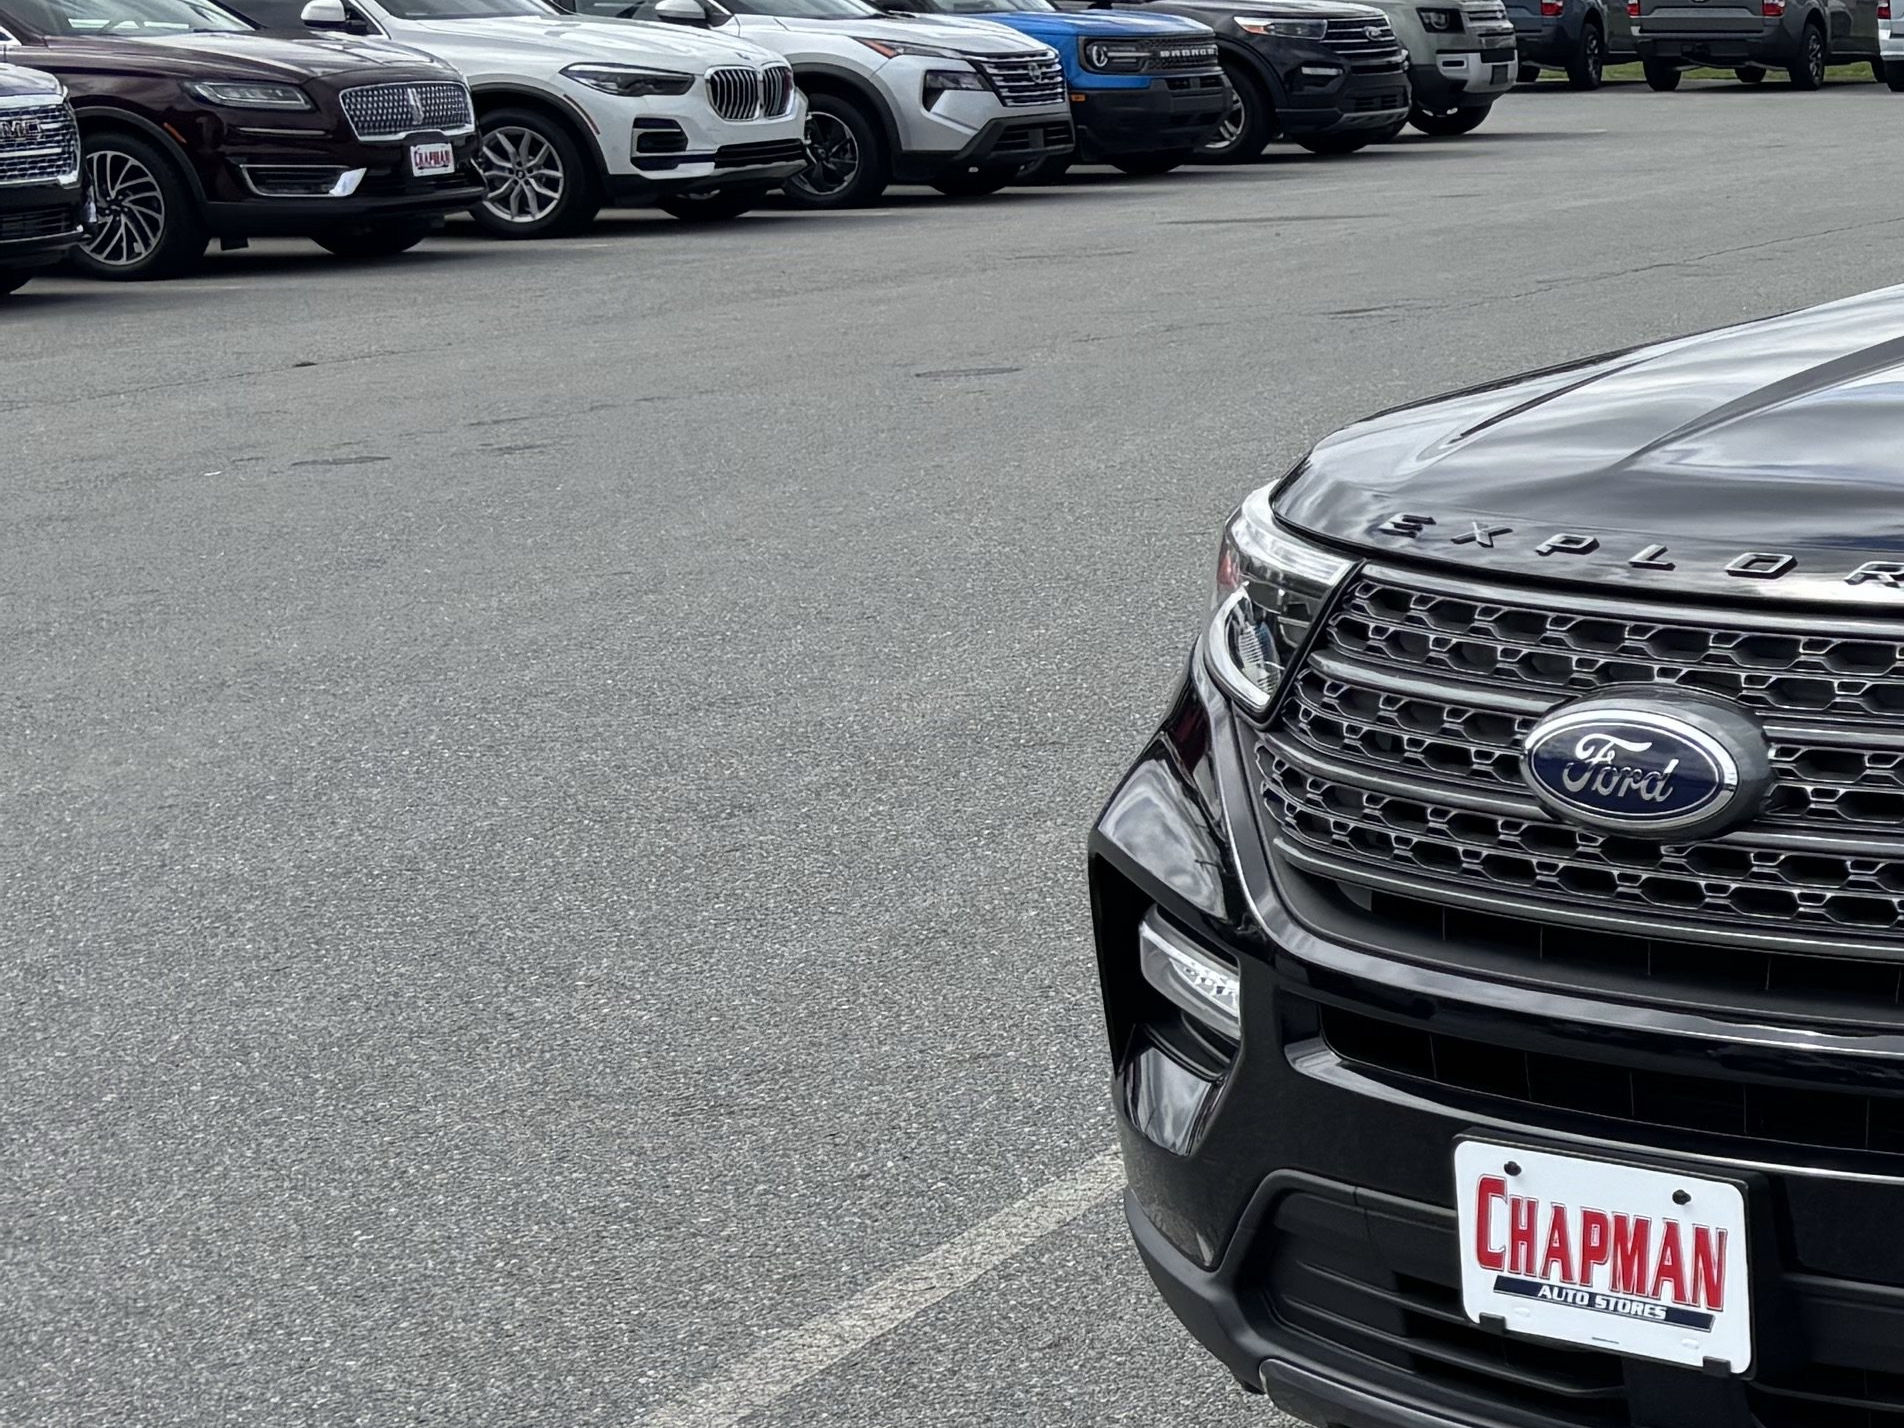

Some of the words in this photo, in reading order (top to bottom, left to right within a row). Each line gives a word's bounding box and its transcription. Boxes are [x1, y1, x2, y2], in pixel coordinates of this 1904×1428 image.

[1562, 732, 1680, 802] Ford
[1476, 1173, 1728, 1312] CHAPMAN
[1537, 1284, 1590, 1306] AUTO
[1594, 1294, 1668, 1321] STORES
